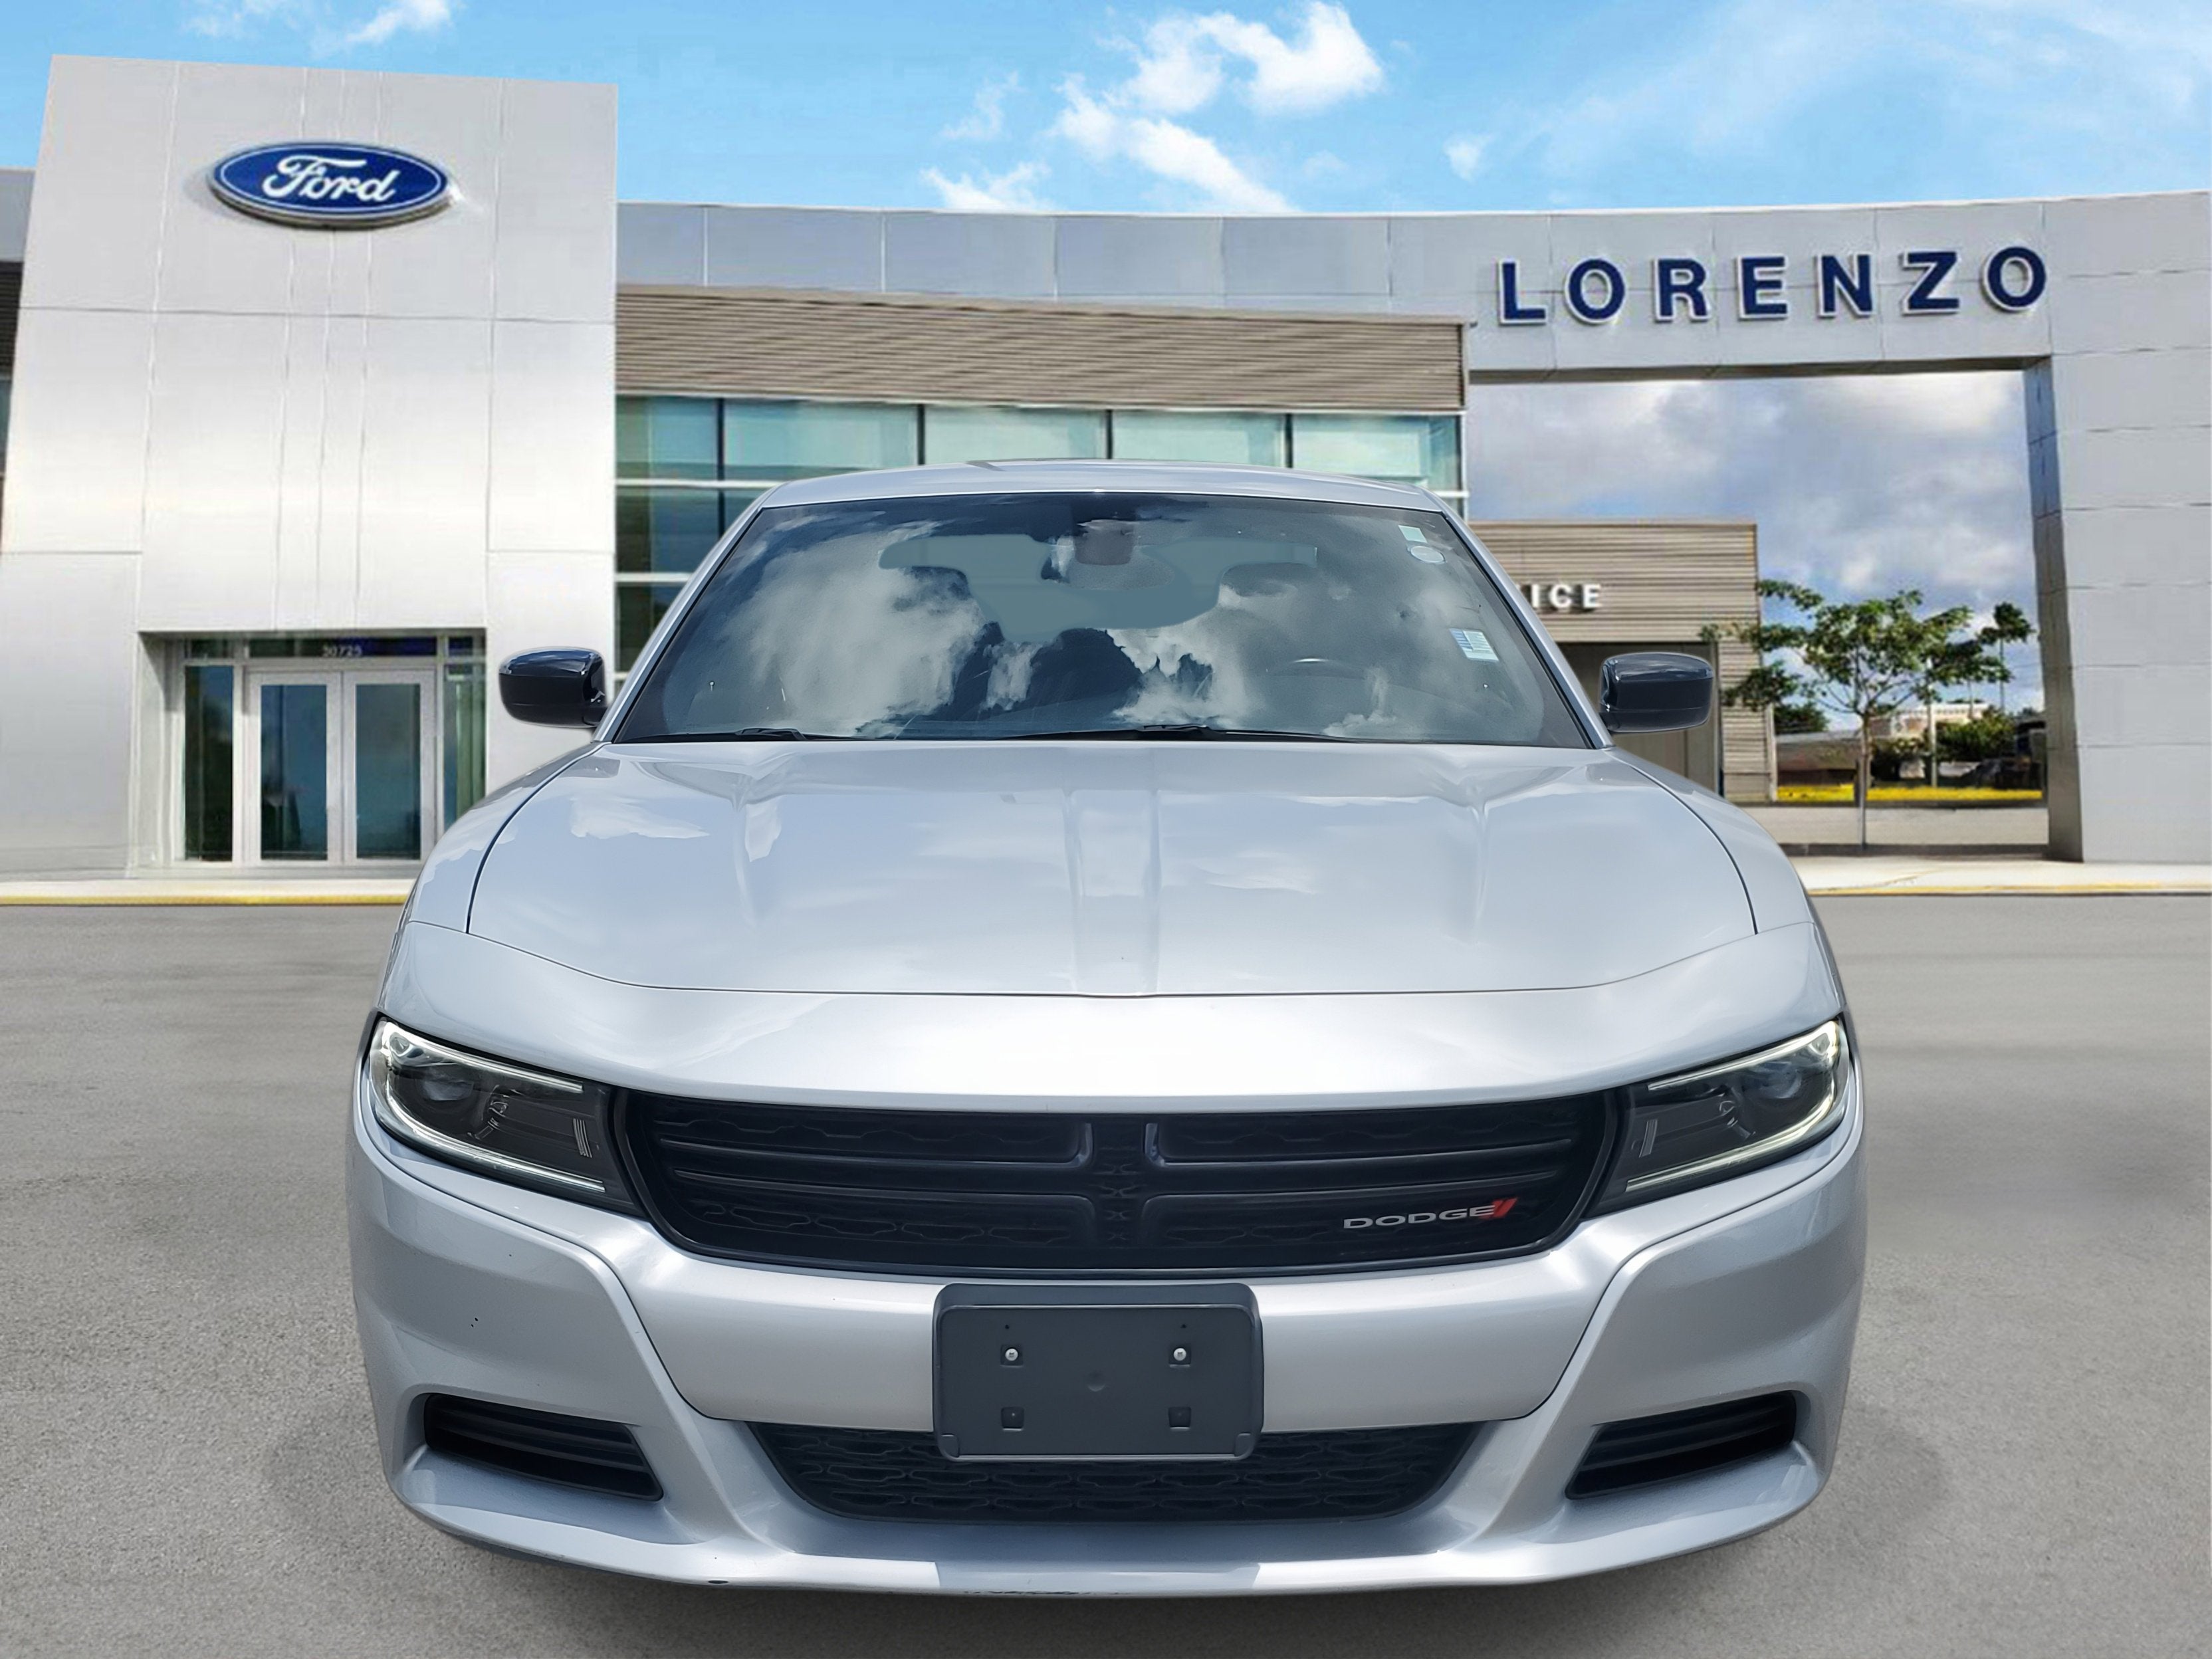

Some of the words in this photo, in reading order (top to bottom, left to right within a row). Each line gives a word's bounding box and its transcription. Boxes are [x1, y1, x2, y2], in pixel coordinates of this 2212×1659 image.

[262, 155, 400, 201] Ford
[1499, 247, 2046, 324] LORENZO
[1516, 584, 1603, 609] ICE
[1343, 1205, 1495, 1229] DODGE
